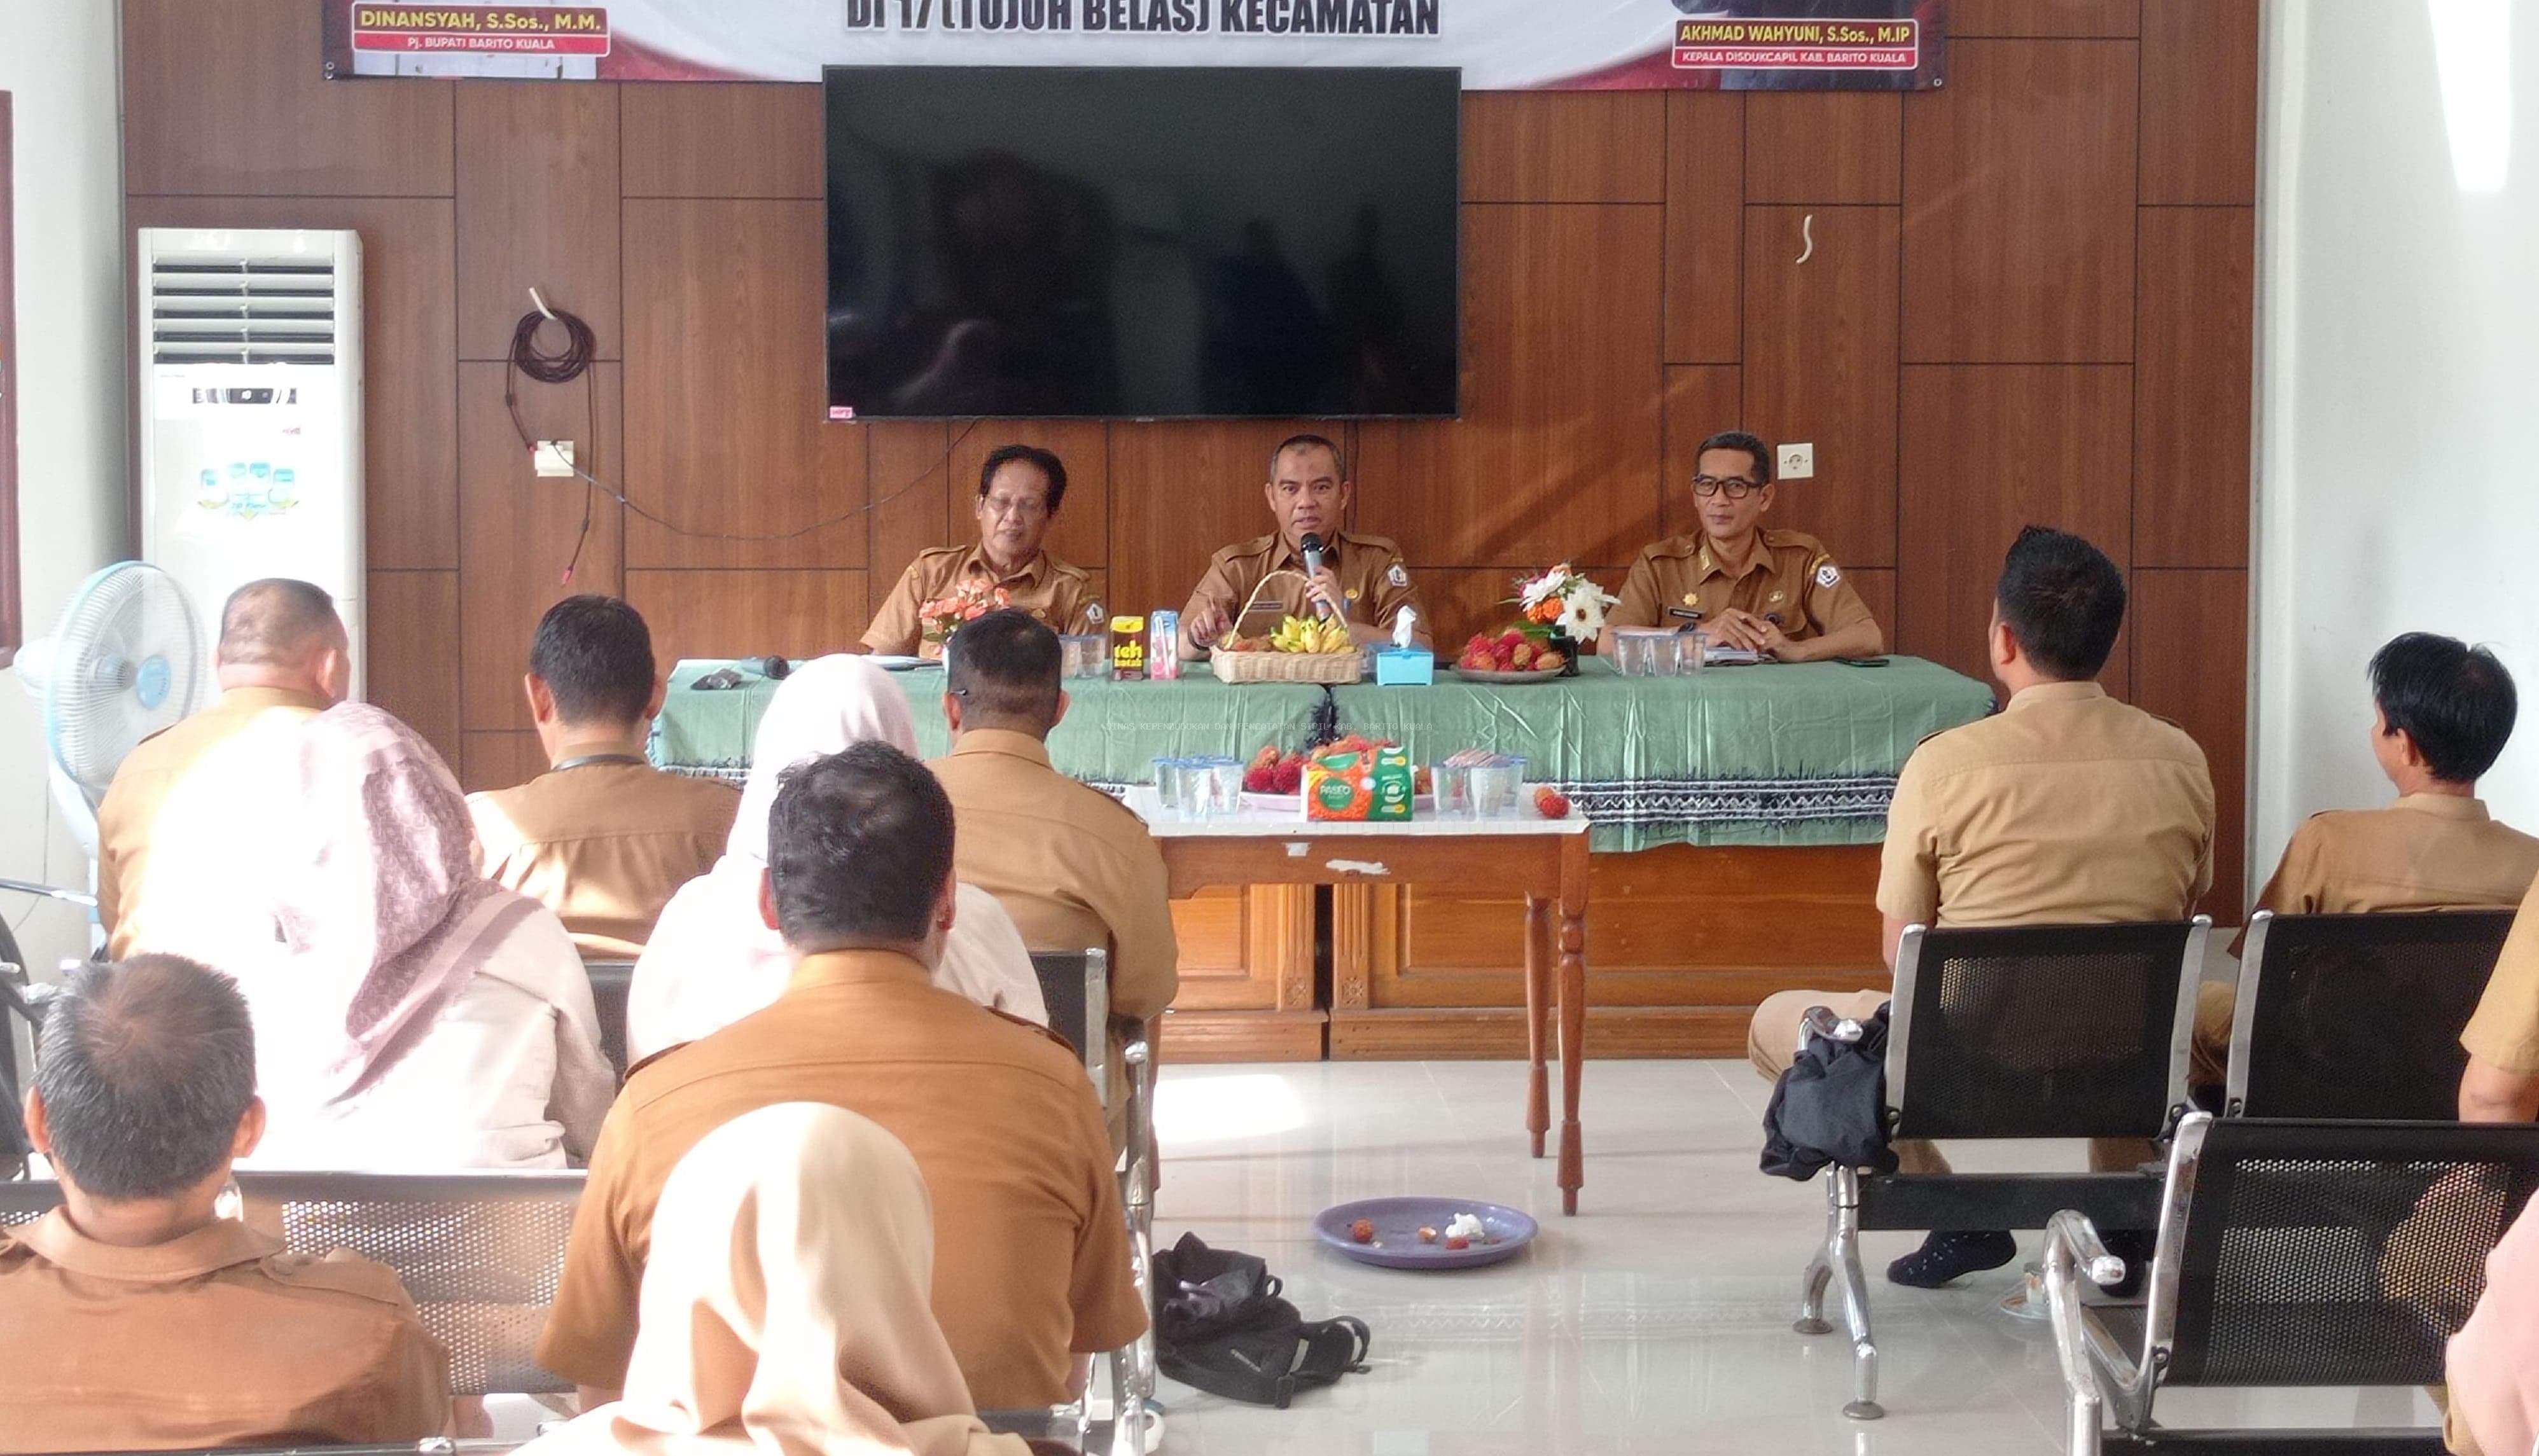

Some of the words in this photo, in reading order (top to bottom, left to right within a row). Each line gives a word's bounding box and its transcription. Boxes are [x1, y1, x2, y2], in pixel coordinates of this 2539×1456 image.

[361, 10, 481, 31] DINANSYAH,
[486, 13, 549, 32] S.Sos.,
[555, 14, 601, 30] M.M.
[847, 0, 884, 27] DI
[1220, 0, 1439, 34] KECAMATAN
[407, 38, 423, 50] Pj.
[425, 38, 466, 48] BUPATI
[468, 39, 513, 49] BARITO
[517, 39, 555, 50] KUALA
[1680, 25, 1744, 42] AKHMAD
[1748, 25, 1824, 45] WAHYUNI,
[1826, 27, 1874, 45] S.Sos.,
[1877, 27, 1910, 43] M.IP
[1682, 52, 1723, 62] KEPALA
[1726, 52, 1798, 62] DISDUKCAPIL
[1800, 52, 1825, 62] KAB.
[1827, 52, 1867, 63] BARITO
[1870, 52, 1906, 63] KUALA
[1115, 639, 1143, 658] teh
